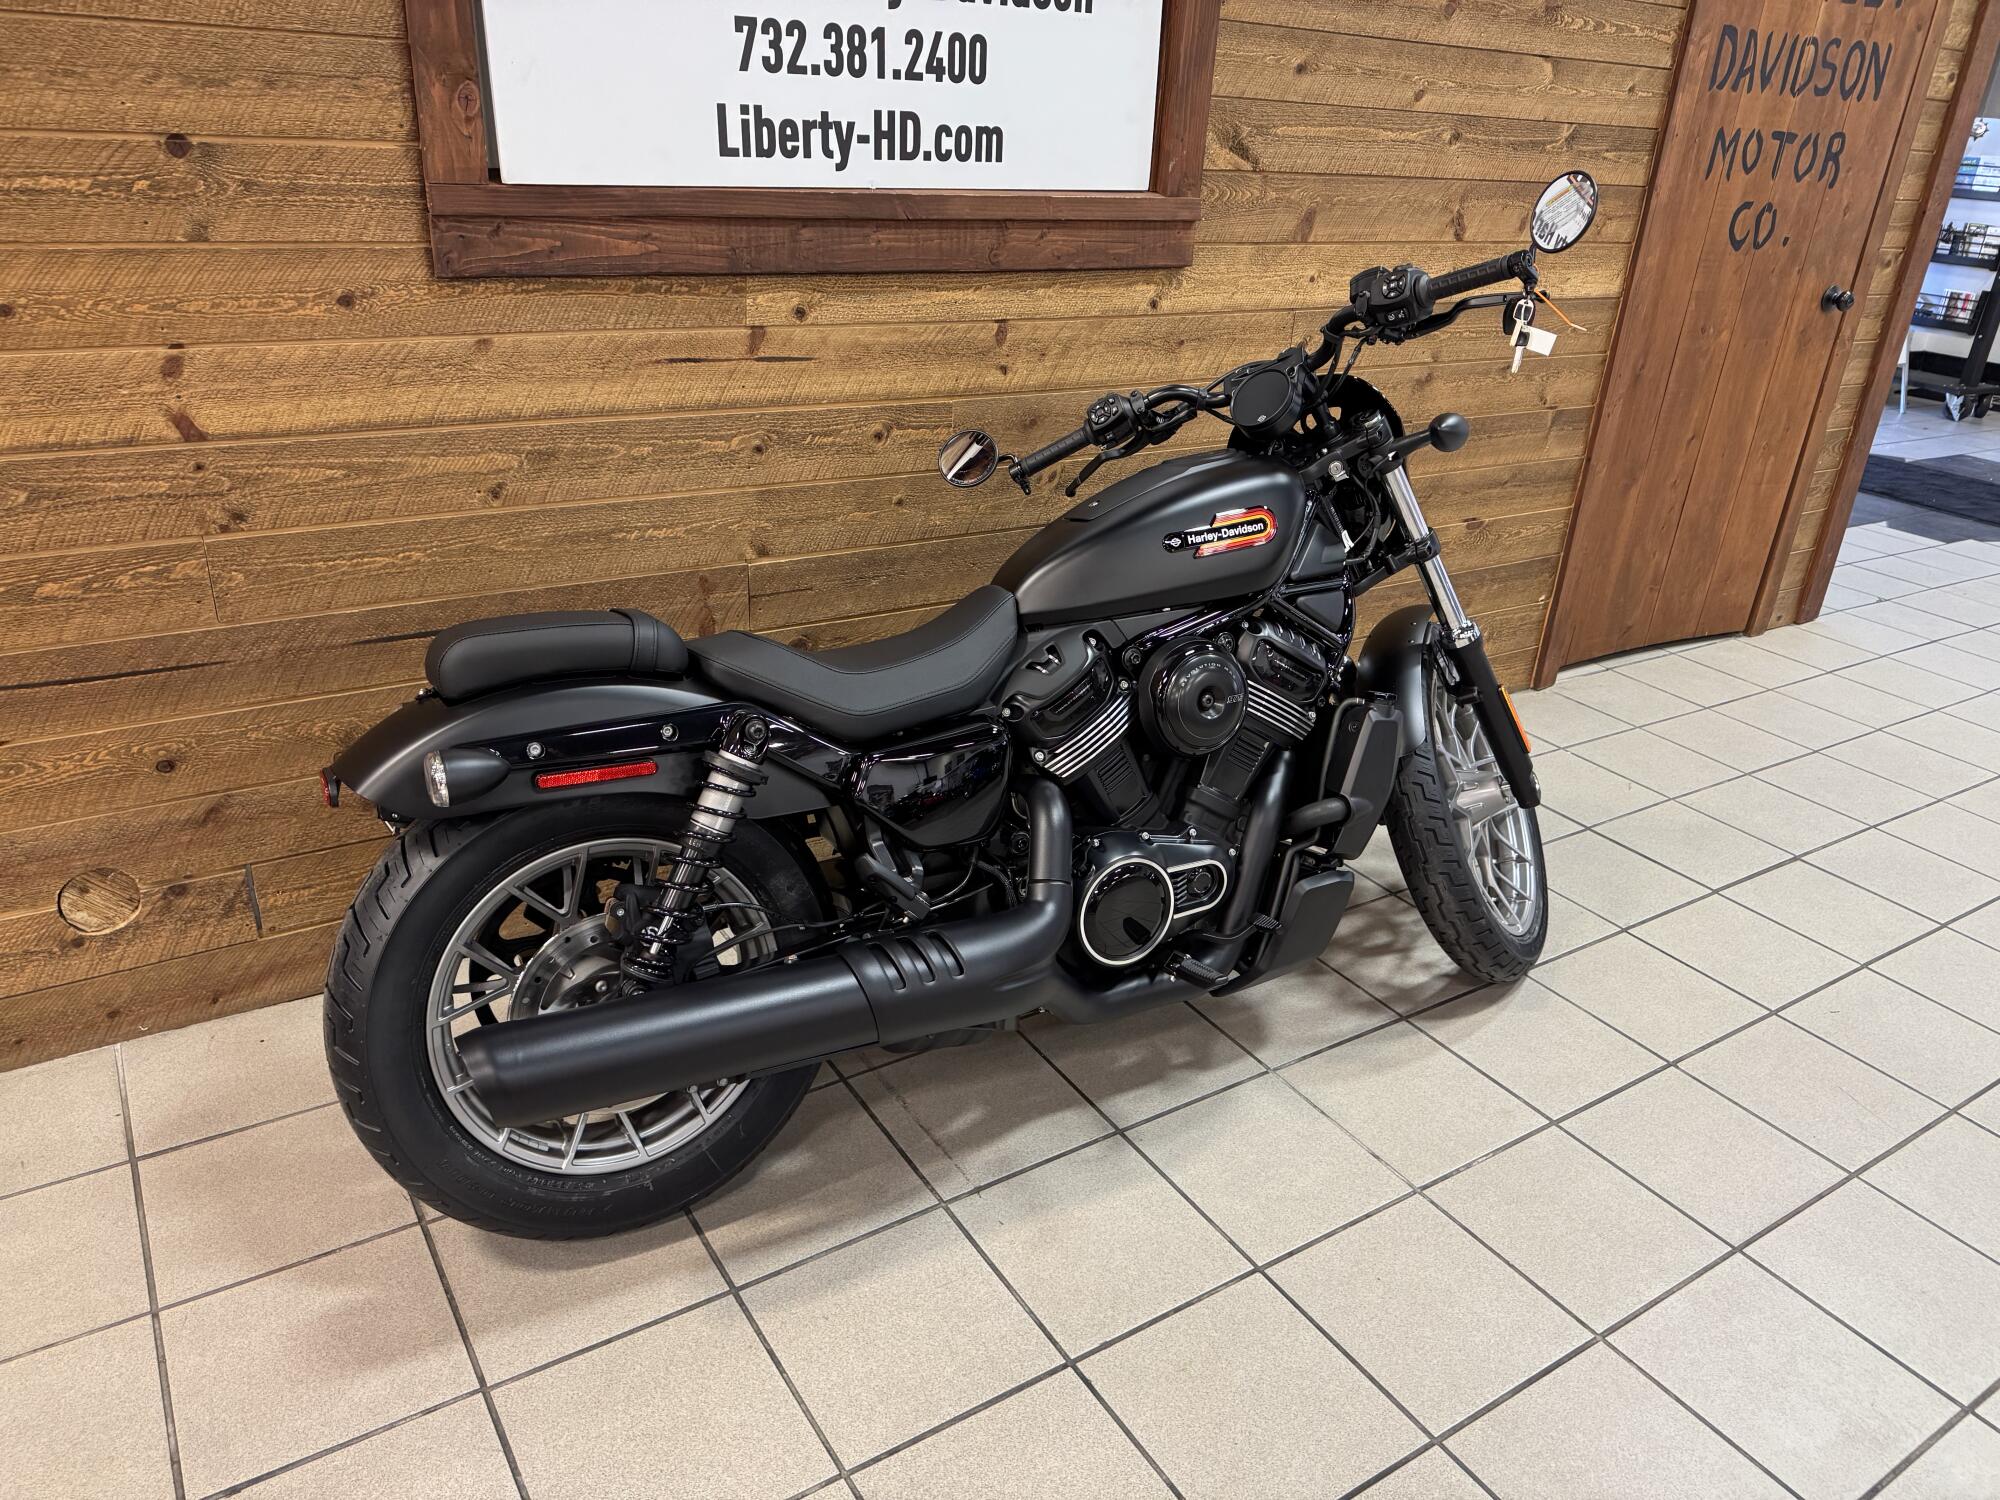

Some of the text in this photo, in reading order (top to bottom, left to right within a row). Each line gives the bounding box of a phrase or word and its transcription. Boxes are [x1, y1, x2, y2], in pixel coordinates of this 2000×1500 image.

[735, 16, 987, 84] 732.381.2400
[1709, 25, 1892, 102] DAVIDSON
[717, 103, 1003, 171] Liberty-HD.com
[1705, 127, 1845, 189] MOTOR
[1729, 201, 1789, 251] CO.
[1187, 522, 1264, 545] Harley-Davidson
